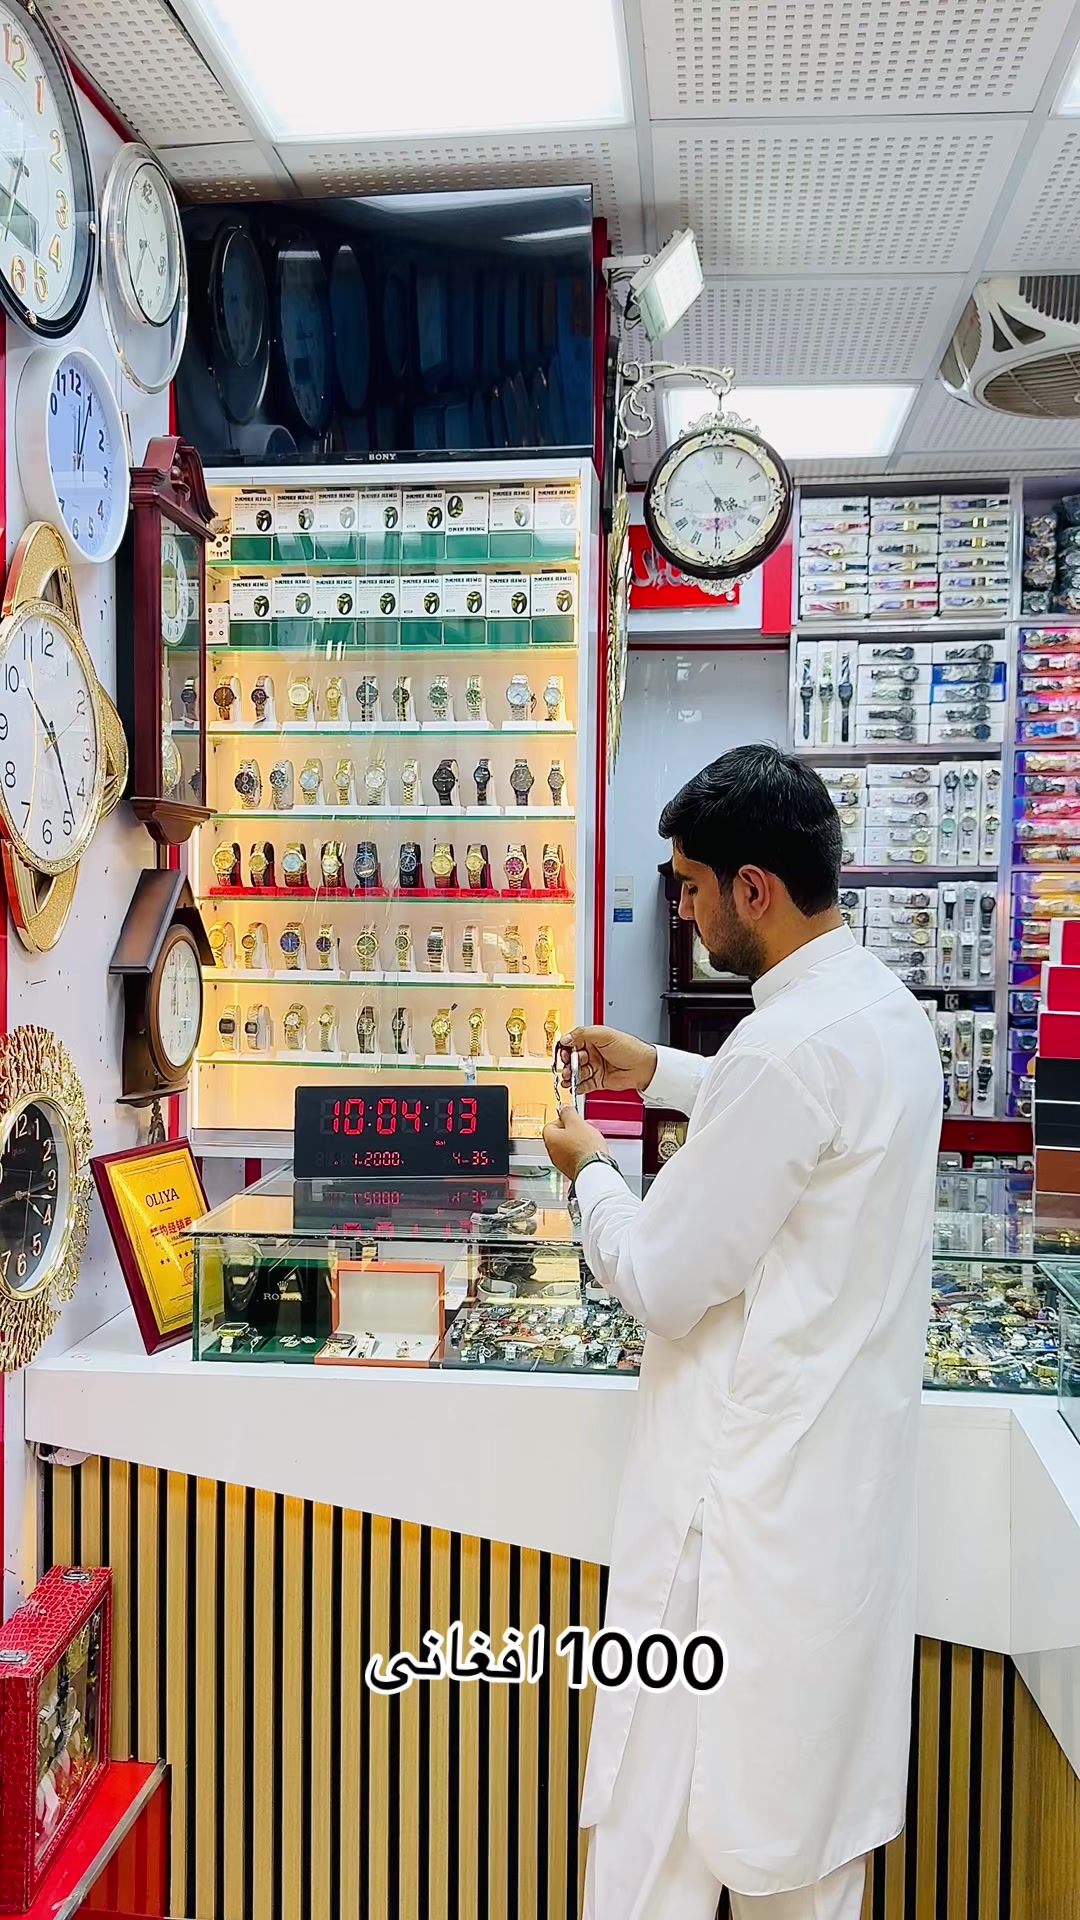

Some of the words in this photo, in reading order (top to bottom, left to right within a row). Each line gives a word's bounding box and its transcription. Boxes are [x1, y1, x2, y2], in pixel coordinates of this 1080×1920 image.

[3, 24, 27, 82] 12
[50, 129, 63, 173] 2
[56, 189, 68, 230] 3
[48, 233, 62, 273] 4
[10, 255, 26, 296] 6
[34, 260, 48, 303] 5
[56, 368, 66, 397] 11
[69, 368, 81, 397] 12
[98, 429, 105, 452] 2
[369, 453, 397, 461] SONY
[103, 466, 109, 488] 3
[97, 499, 104, 521] 4
[72, 518, 79, 540] 6
[88, 515, 94, 539] 5
[23, 633, 33, 662] 11
[41, 627, 54, 658] 12
[5, 663, 20, 693] 10
[76, 689, 86, 716] 2
[82, 738, 91, 762] 3
[4, 760, 16, 788] 8
[76, 777, 86, 802] 4
[21, 800, 31, 829] 7
[62, 810, 73, 836] 5
[42, 819, 53, 845] 6
[15, 1113, 28, 1139] 12
[34, 1117, 40, 1141] 1
[42, 1138, 52, 1162] 2
[47, 1169, 57, 1191] 3
[145, 1188, 180, 1208] OLIYA
[42, 1203, 53, 1227] 4
[32, 1232, 42, 1257] 5
[1, 1249, 12, 1277] 7
[17, 1252, 27, 1277] 6
